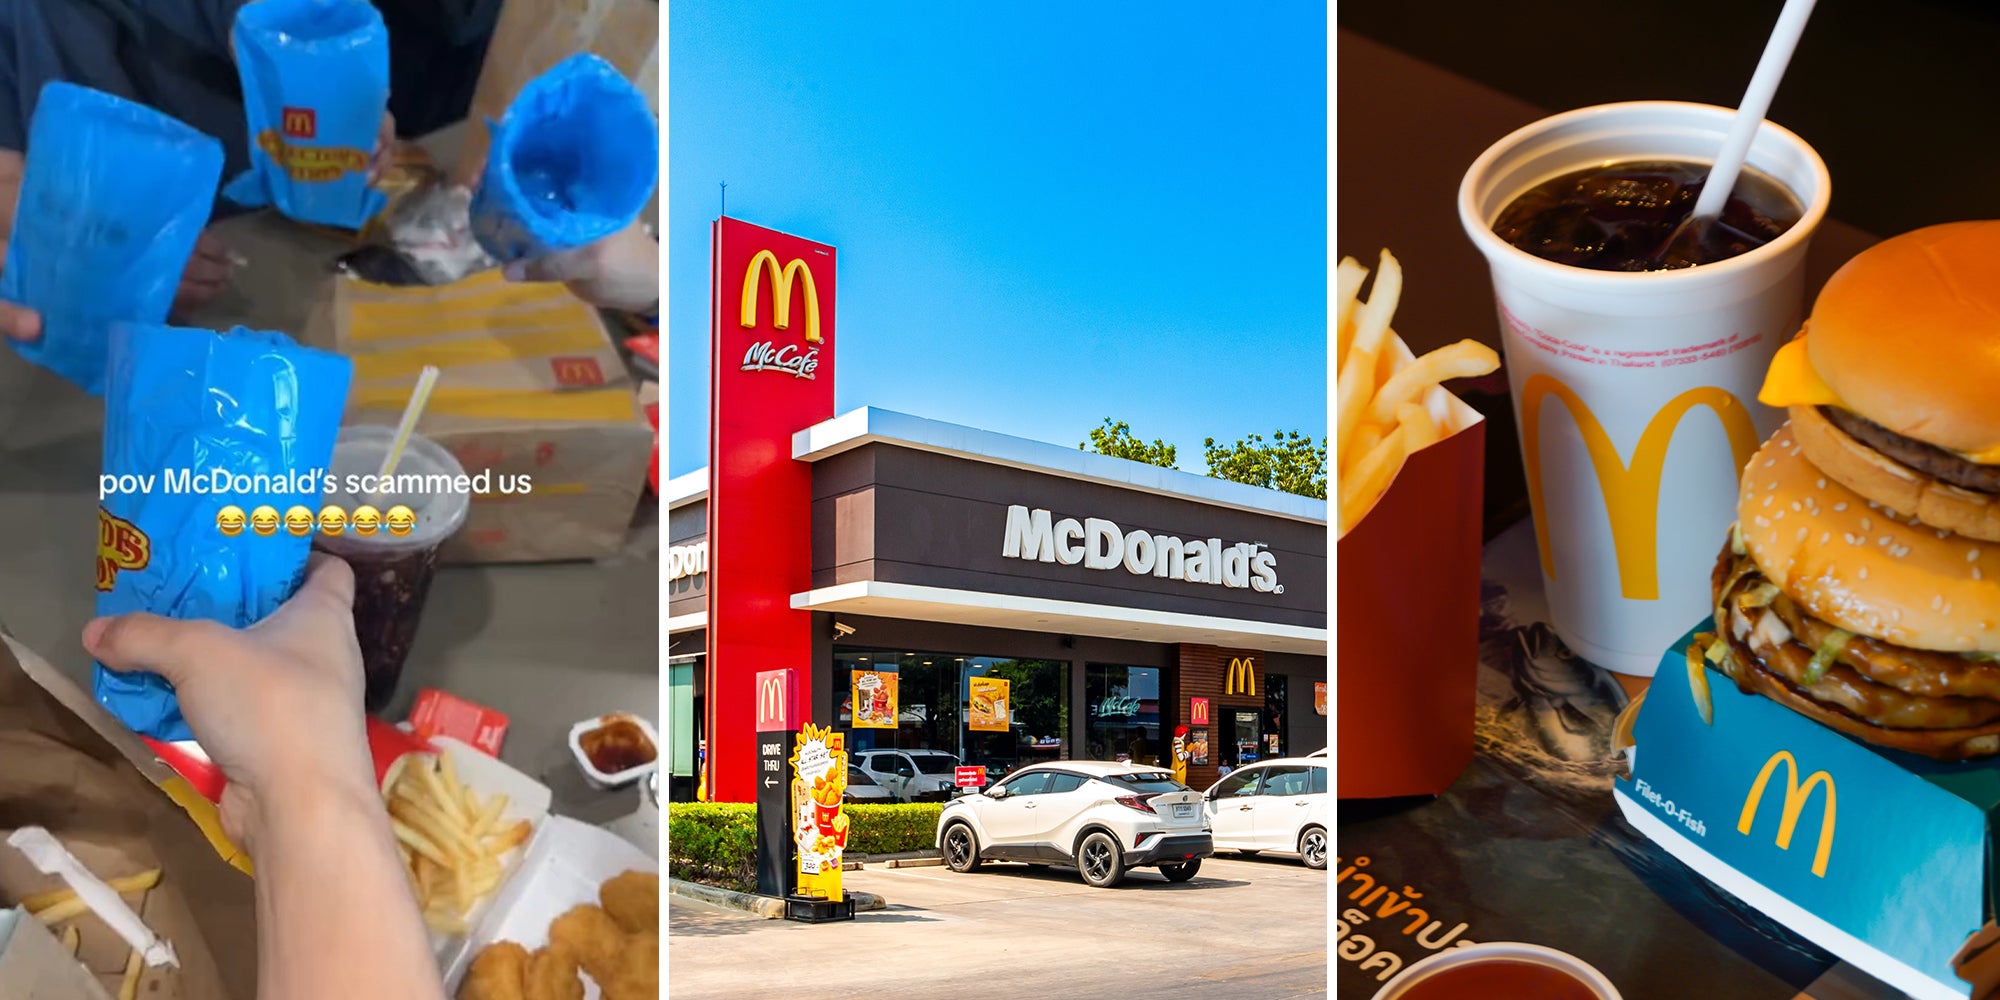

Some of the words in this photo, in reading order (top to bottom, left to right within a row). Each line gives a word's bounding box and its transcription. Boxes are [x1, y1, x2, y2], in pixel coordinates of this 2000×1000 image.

[1002, 504, 1278, 593] McDonald's
[762, 743, 781, 756] DRIVE
[764, 760, 780, 772] THRU
[1634, 778, 1707, 837] Filet-O-Fish
